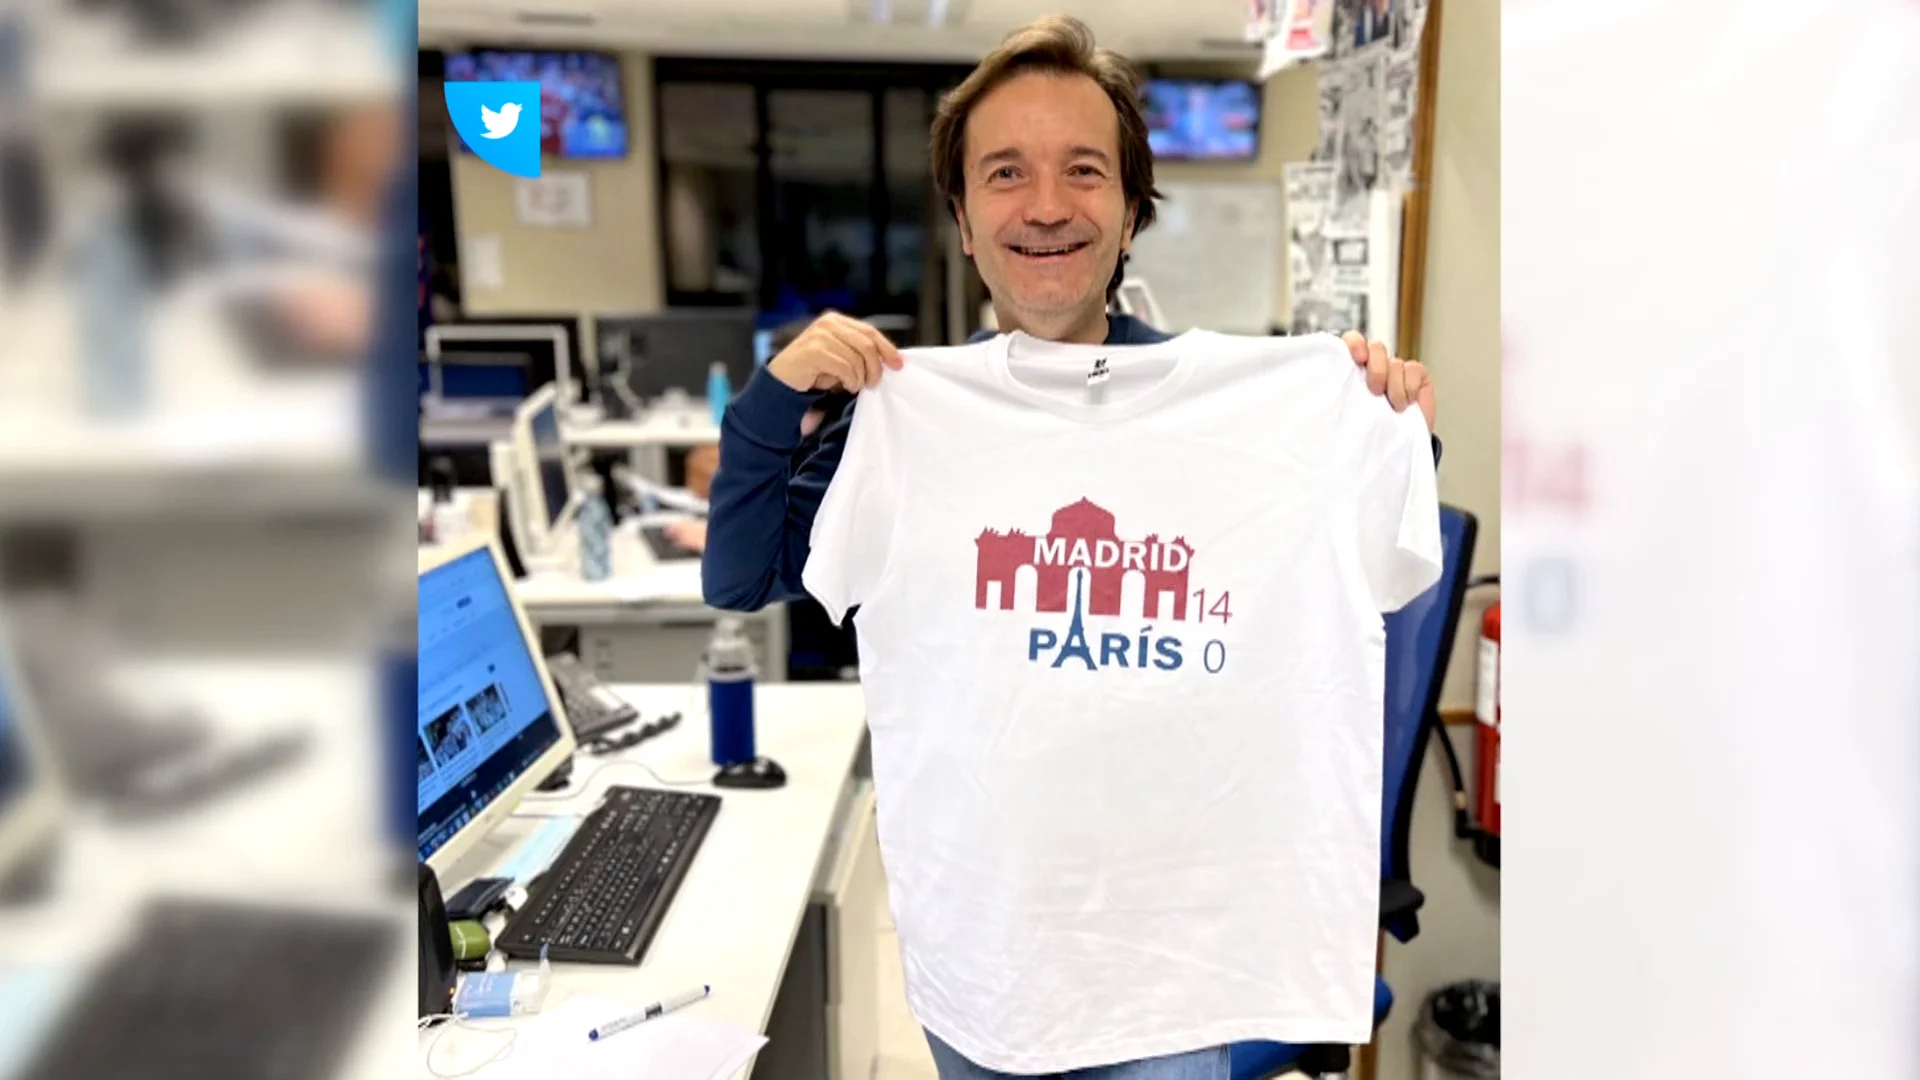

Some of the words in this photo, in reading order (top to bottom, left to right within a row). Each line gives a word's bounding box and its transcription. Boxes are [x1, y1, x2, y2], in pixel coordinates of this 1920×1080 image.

[1033, 537, 1189, 572] MADRID
[1193, 588, 1233, 625] 14
[1029, 612, 1184, 671] PARÍS
[1203, 638, 1226, 674] 0
